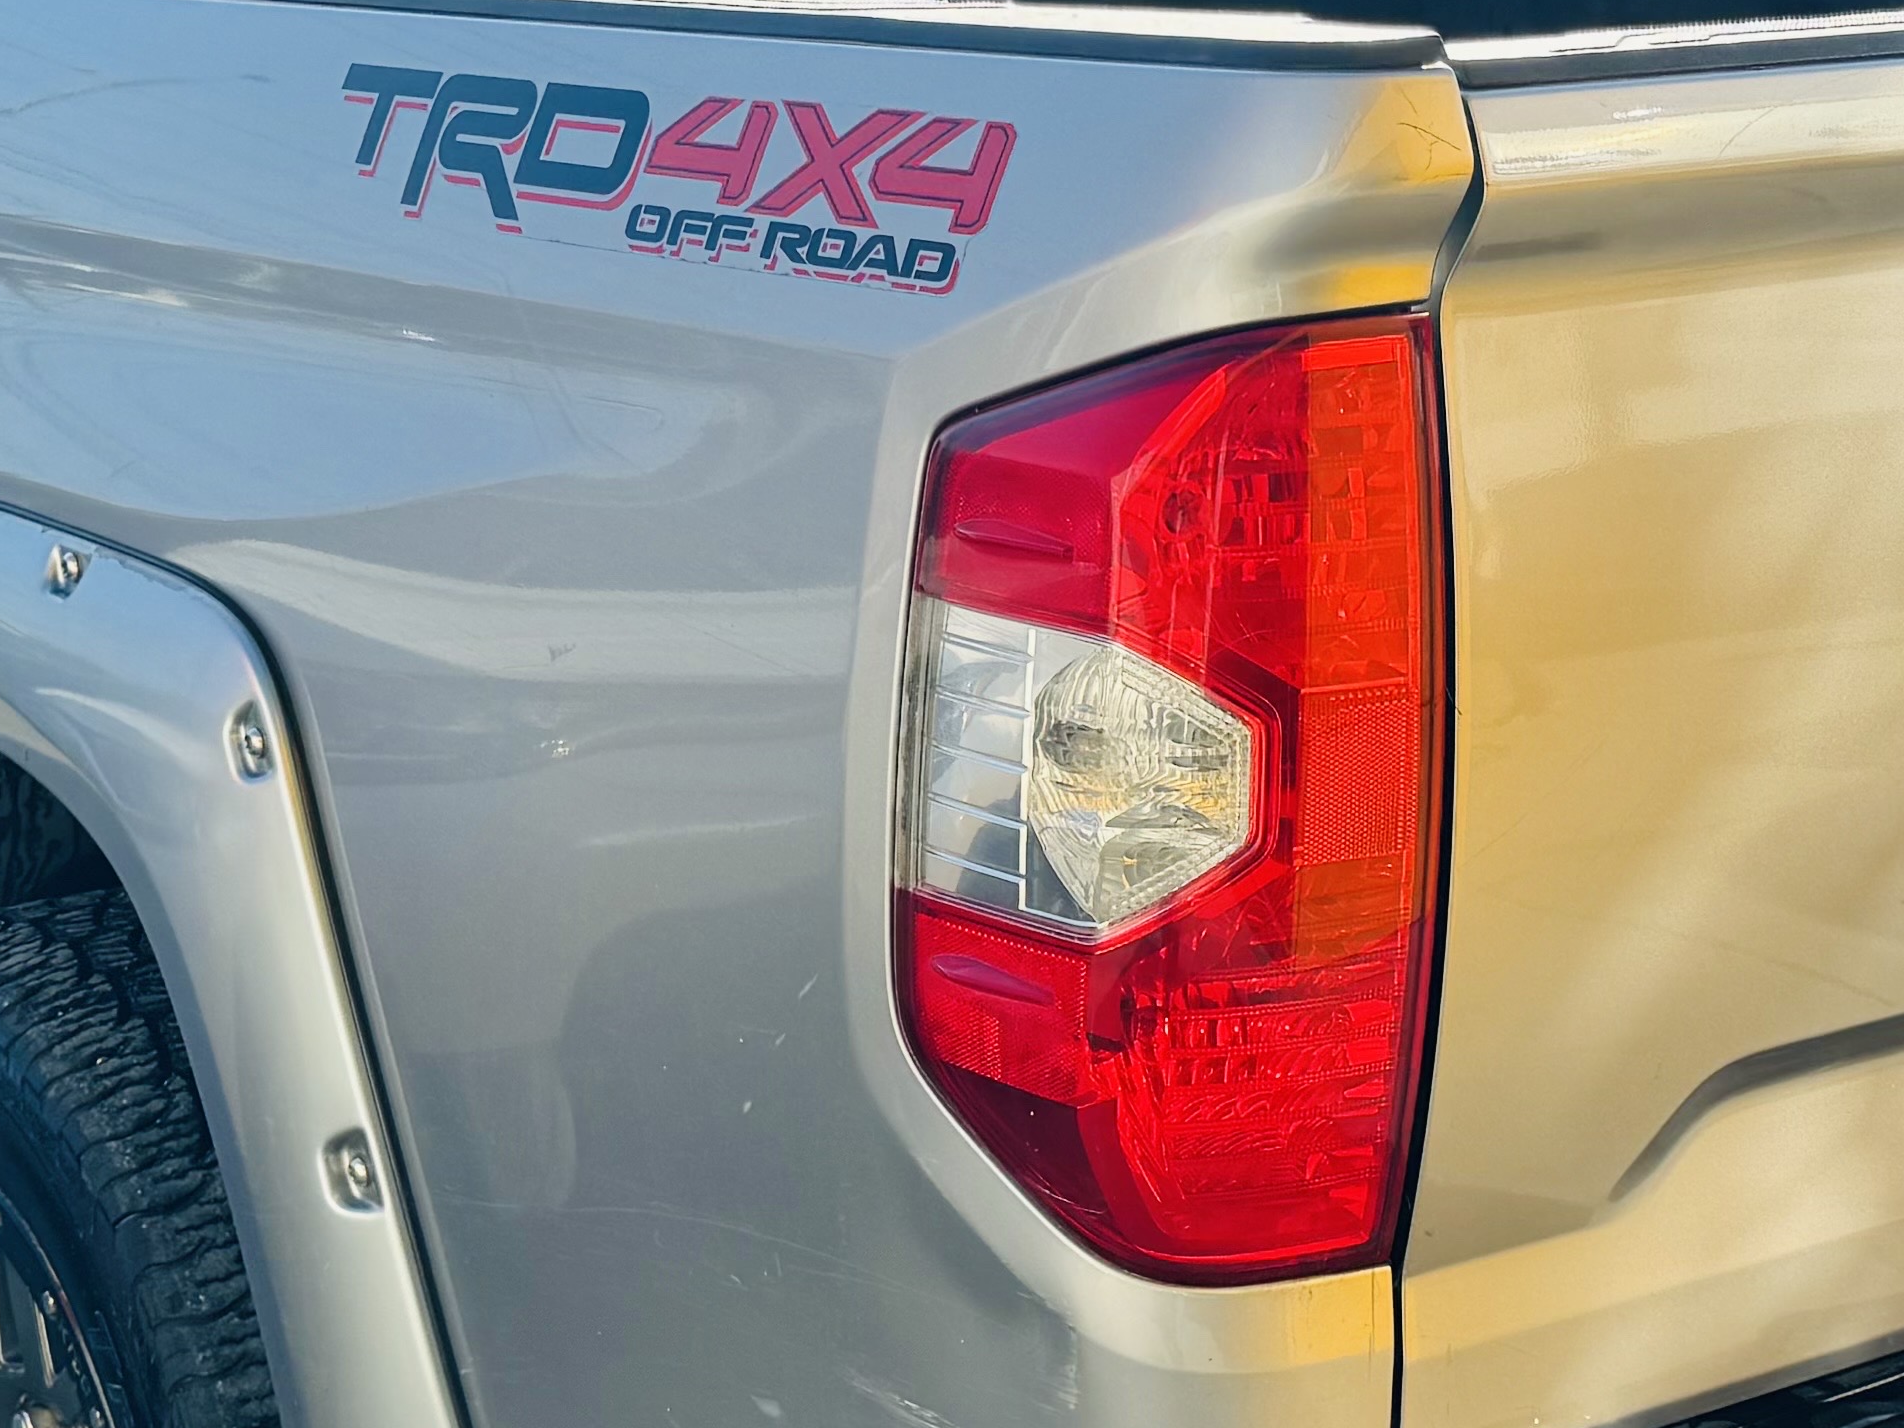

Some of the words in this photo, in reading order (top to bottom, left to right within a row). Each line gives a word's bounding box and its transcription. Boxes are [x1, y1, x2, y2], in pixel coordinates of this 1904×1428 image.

[342, 63, 653, 235] TRD
[625, 204, 757, 264] OFF
[759, 220, 962, 297] ROAD
